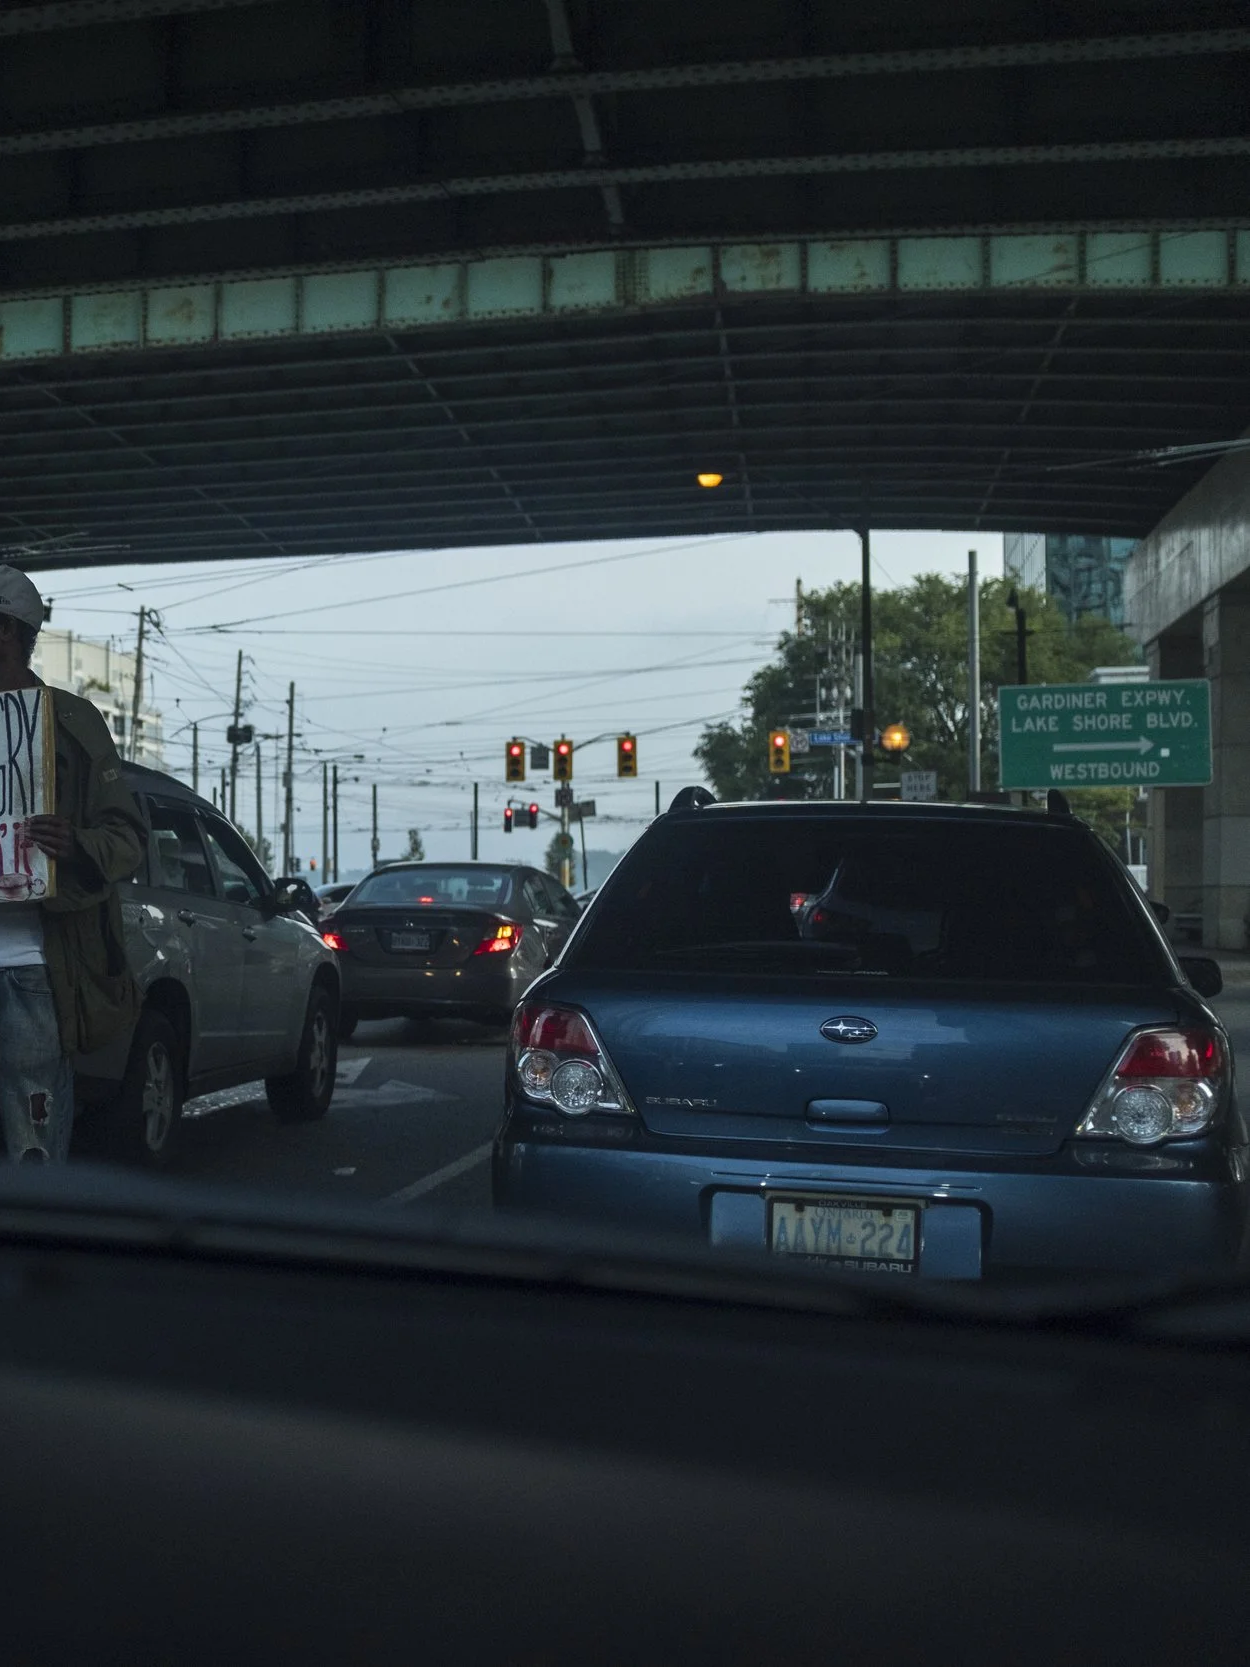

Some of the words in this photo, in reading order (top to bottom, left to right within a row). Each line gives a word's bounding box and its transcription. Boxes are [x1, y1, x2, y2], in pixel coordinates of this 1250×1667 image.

[1017, 691, 1108, 711] GARDINER
[1121, 689, 1192, 708] EXPWY.
[1011, 716, 1060, 733] LAKE
[1072, 713, 1133, 731] SHORE
[1146, 711, 1199, 729] BLVD.
[1050, 761, 1160, 780] WESTBOUND
[815, 1207, 874, 1220] ONTARIO
[845, 1260, 914, 1273] SUBARU
